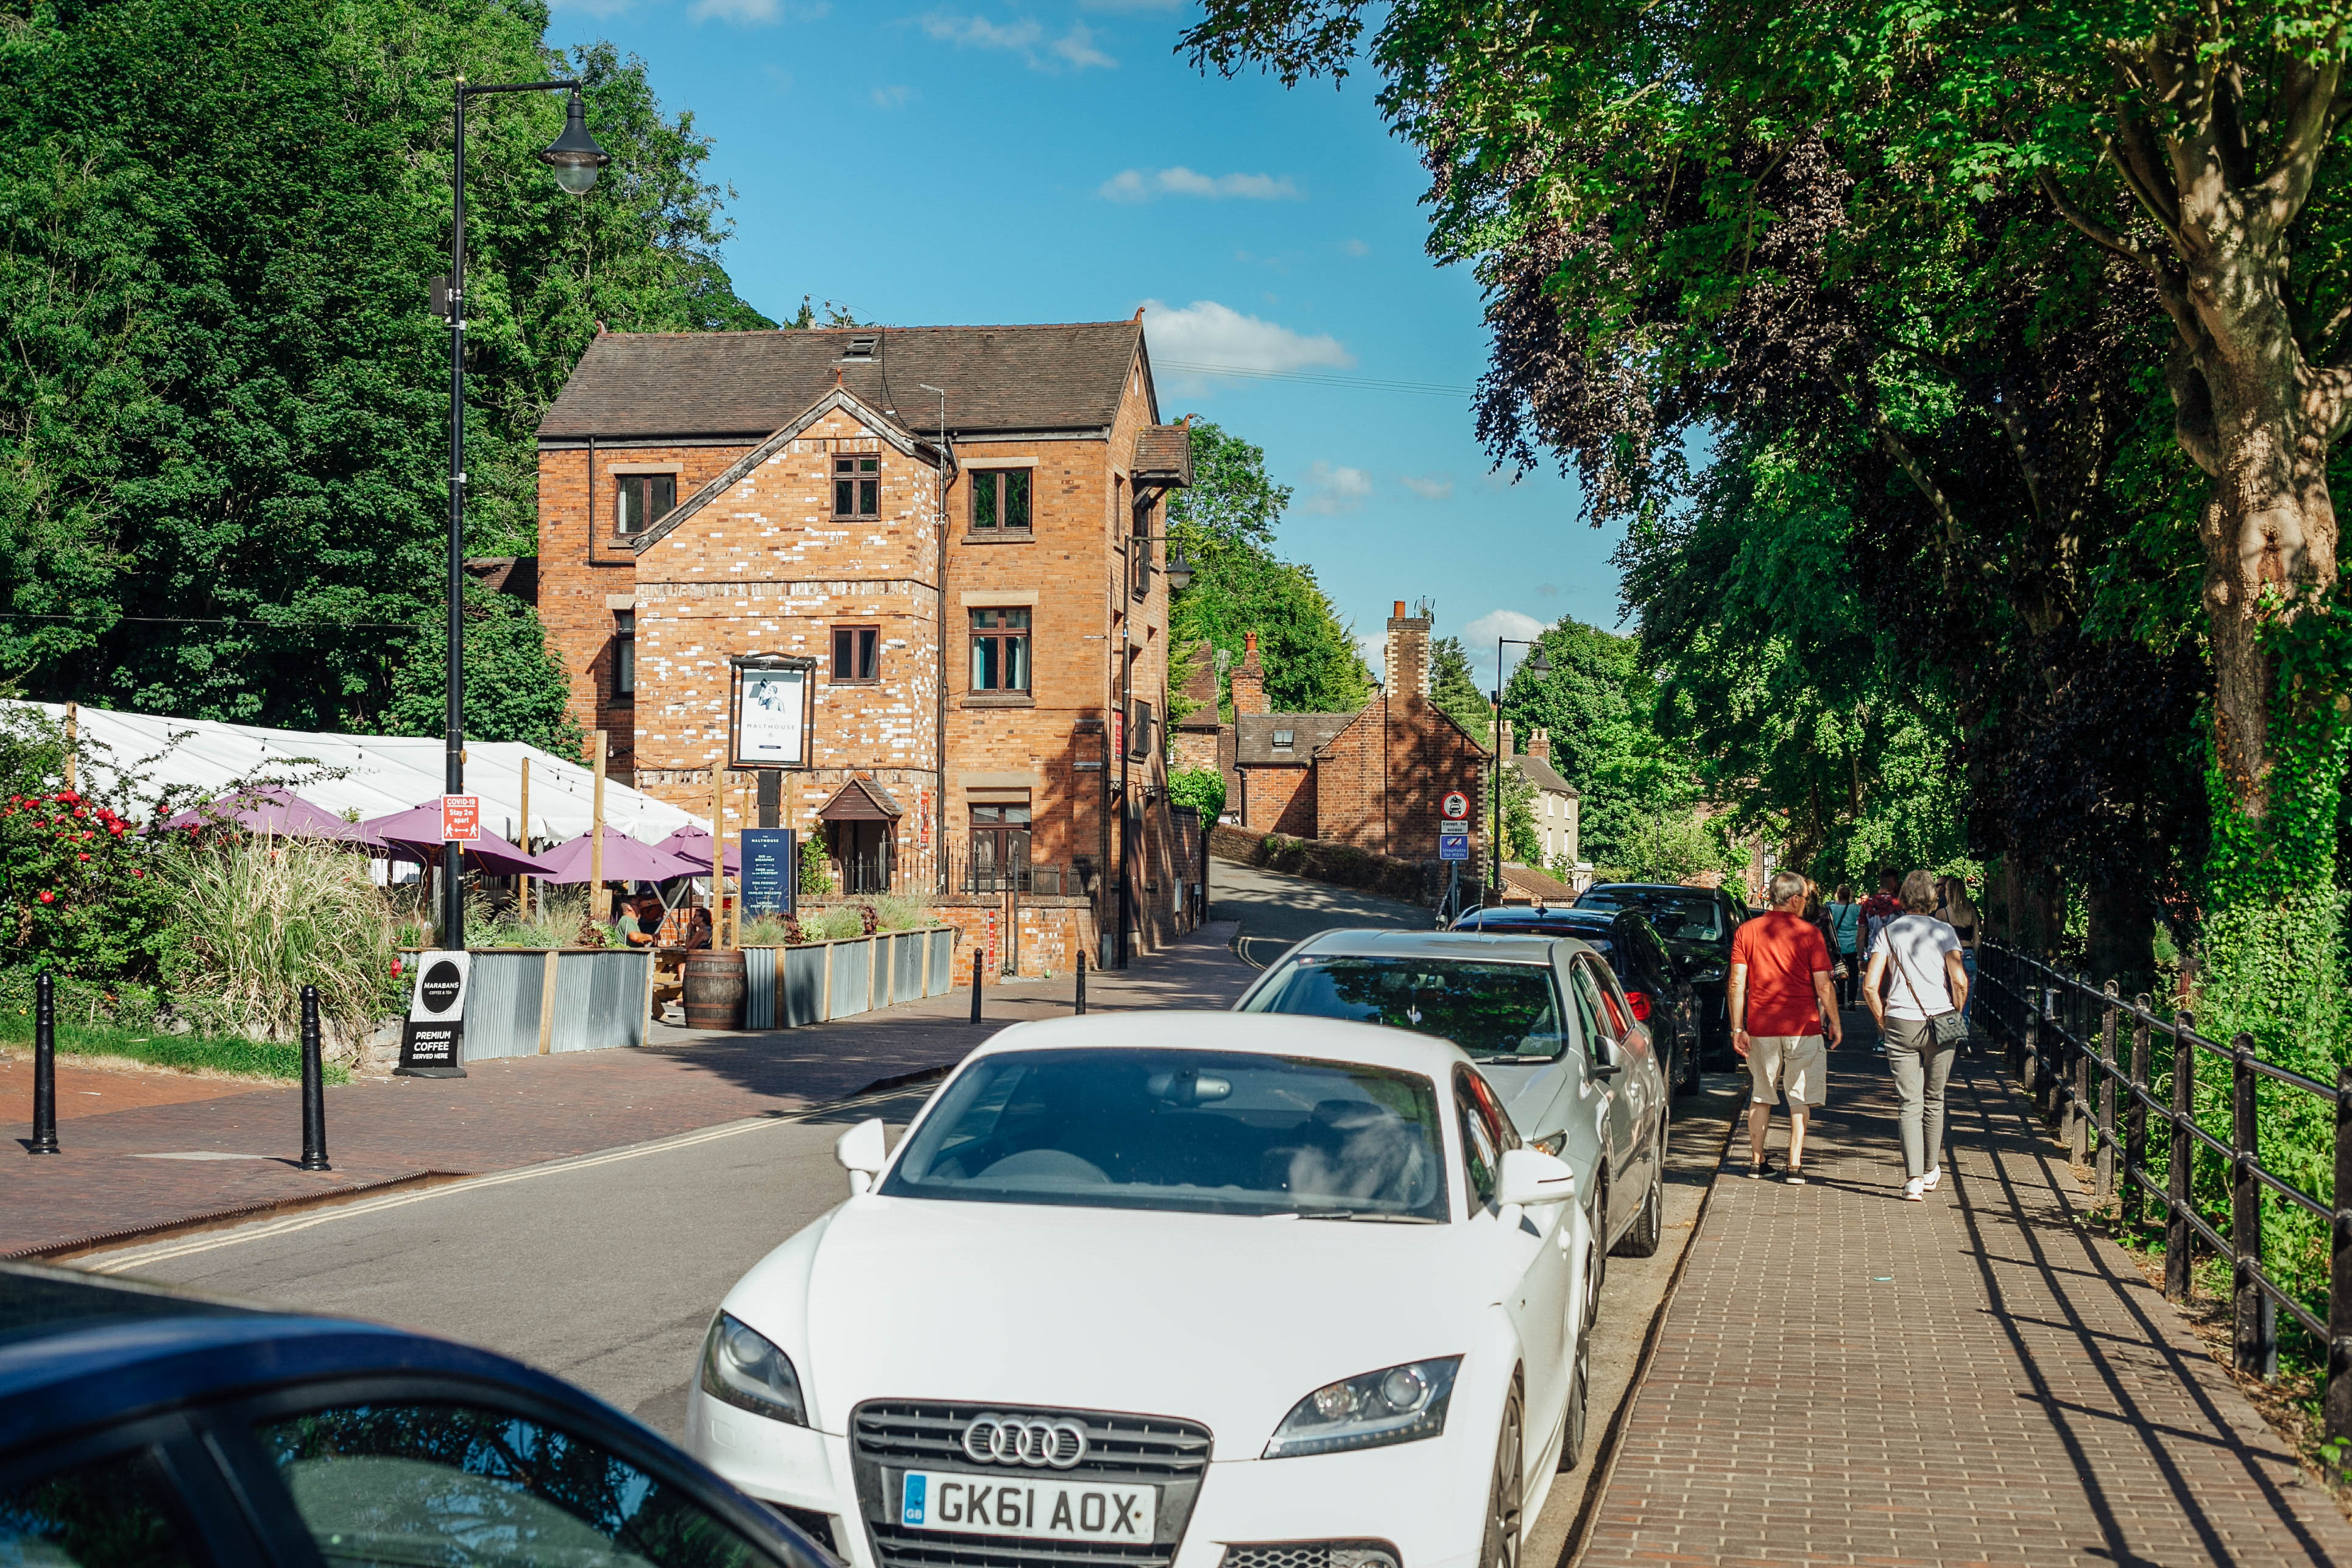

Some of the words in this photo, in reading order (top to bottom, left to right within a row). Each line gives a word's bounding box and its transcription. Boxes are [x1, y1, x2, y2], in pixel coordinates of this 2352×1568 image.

[449, 808, 463, 817] Stay
[415, 1031, 451, 1040] PREMIUM
[414, 1041, 450, 1051] COFFEE
[939, 1482, 1034, 1528] GK61
[1050, 1491, 1137, 1534] AOX
[906, 1508, 923, 1520] GB
